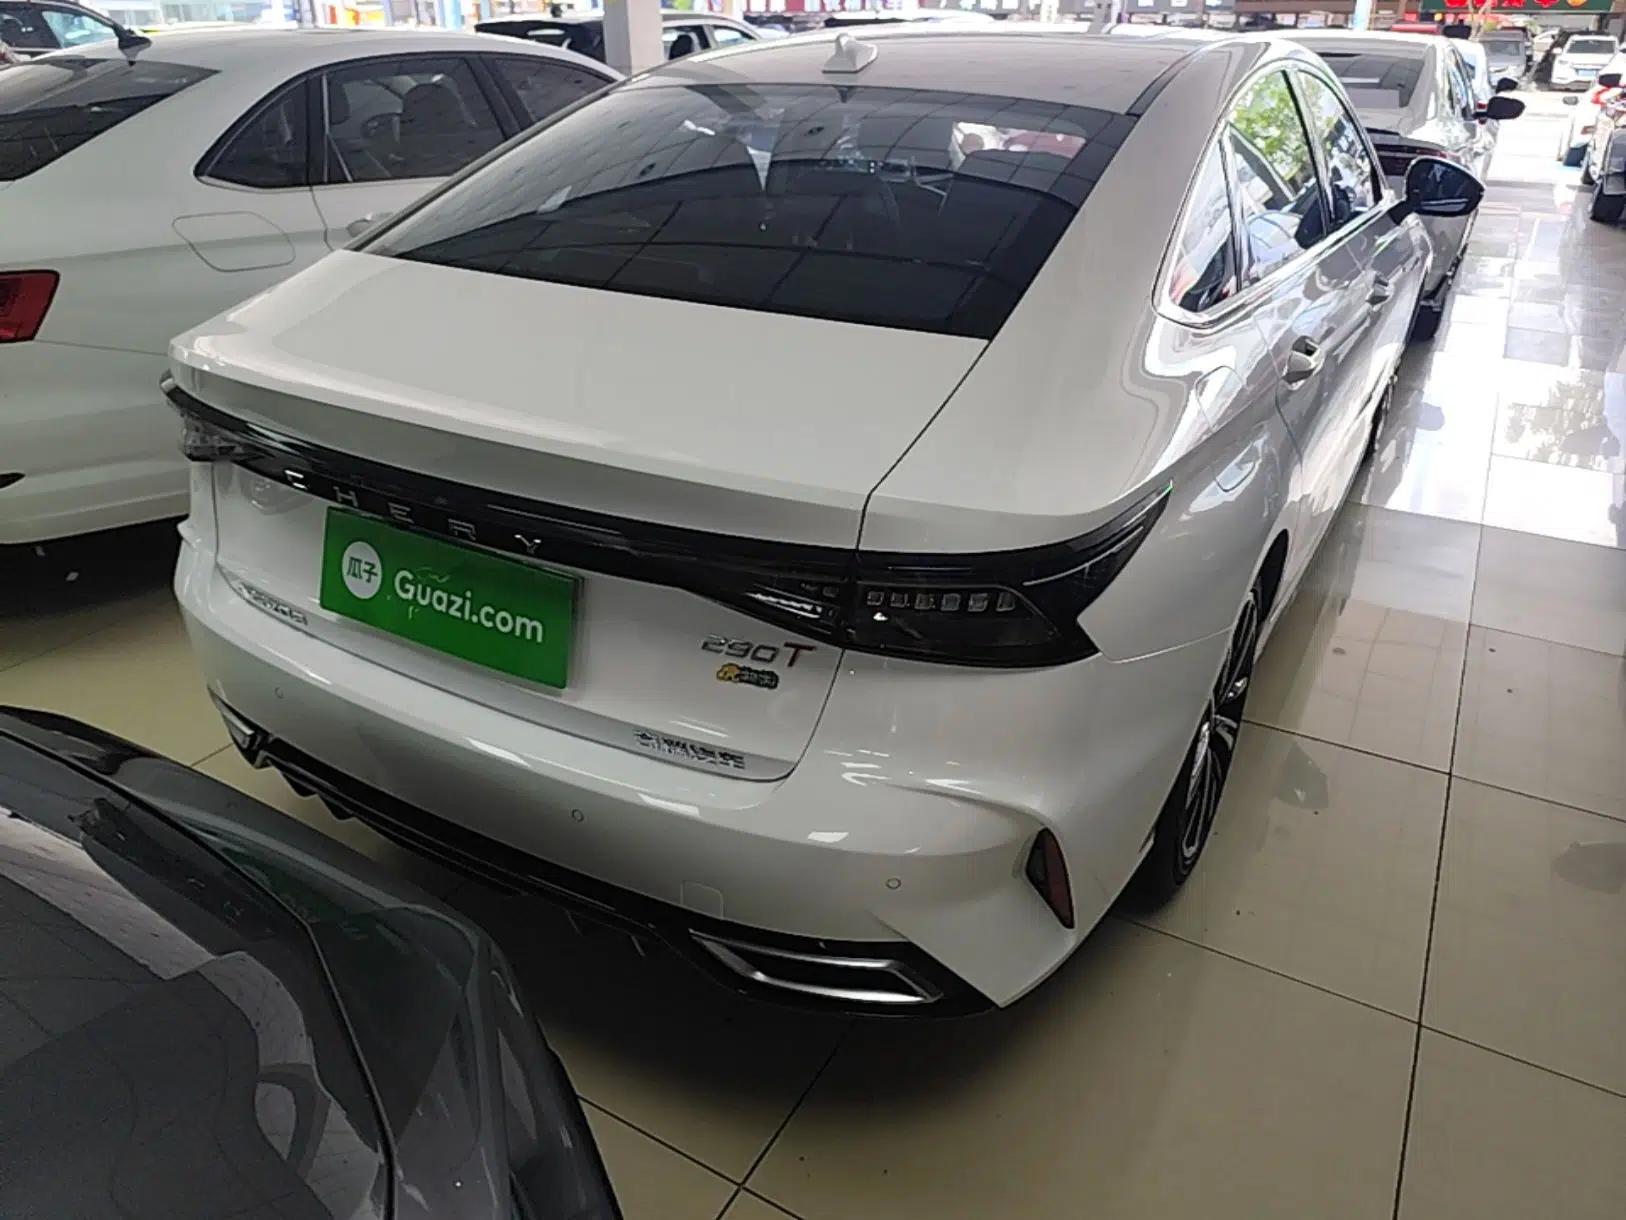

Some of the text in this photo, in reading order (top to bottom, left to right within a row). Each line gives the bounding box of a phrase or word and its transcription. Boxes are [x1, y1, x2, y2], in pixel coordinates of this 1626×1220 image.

[285, 470, 541, 553] CHERY
[346, 556, 379, 584] 瓜子
[394, 571, 544, 643] Guazi.com
[701, 634, 817, 667] 290T
